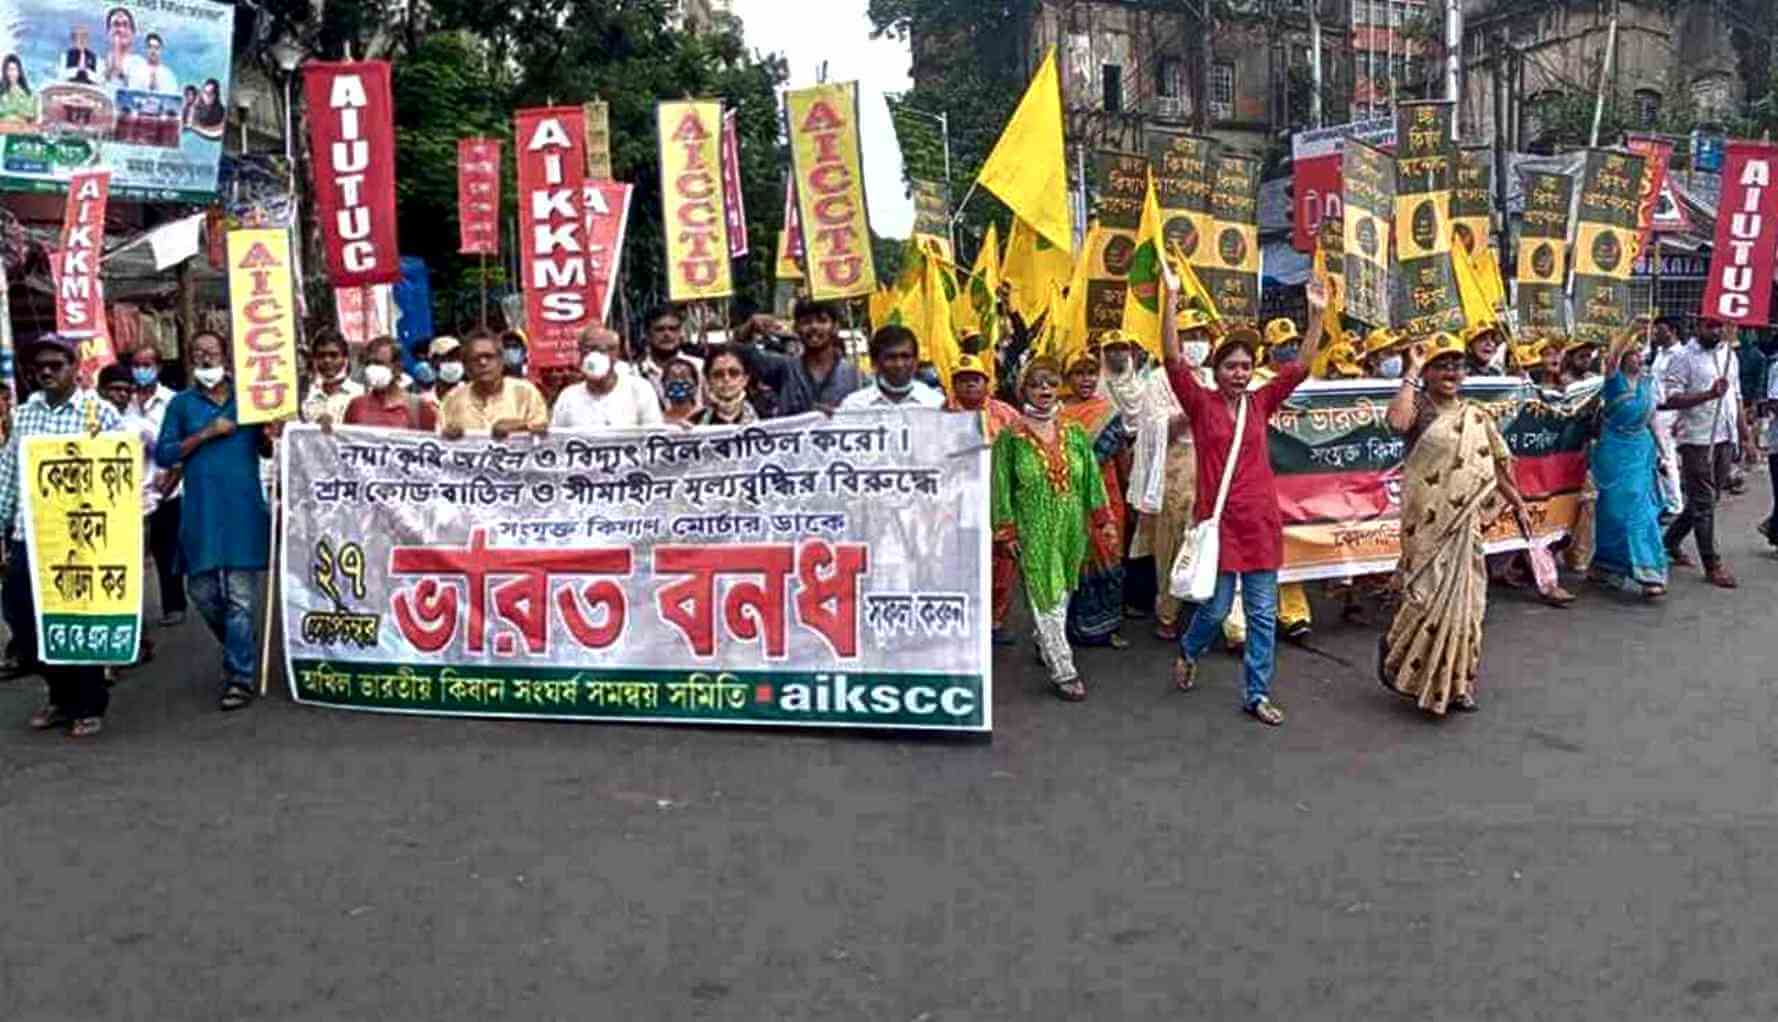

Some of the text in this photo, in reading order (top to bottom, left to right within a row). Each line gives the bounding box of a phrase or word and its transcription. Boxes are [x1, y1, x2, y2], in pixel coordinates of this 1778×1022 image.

[329, 74, 377, 273] AIUTUC
[528, 118, 587, 322] AIKKMS
[672, 112, 720, 287] AICCTU
[800, 101, 864, 288] AICCTU
[61, 179, 99, 324] AIKKMS
[1717, 160, 1770, 318] AIUTUC
[238, 241, 289, 411] AICCTU
[97, 441, 134, 507] কৃষি
[316, 480, 357, 501] শ্রম
[366, 481, 433, 502] কোড
[440, 477, 525, 504] বাতিল
[532, 484, 555, 503] ও
[566, 474, 674, 504] সীমাহীন
[827, 462, 940, 497] বিরুদ্ধে
[396, 442, 445, 473] কৃষি
[453, 444, 528, 470] আইন
[535, 449, 557, 468] ও
[568, 438, 639, 472] বিদ্যুৎ
[647, 435, 700, 465] বিল
[711, 428, 800, 458] বাতিল
[812, 427, 887, 452] করো
[314, 538, 365, 602] ২৭
[772, 513, 845, 534] ডাকে
[97, 565, 128, 600] কর
[390, 528, 633, 655] ভারত
[652, 538, 869, 661] বনধ
[667, 673, 747, 710] সমিতি
[781, 675, 975, 715] aikscc
